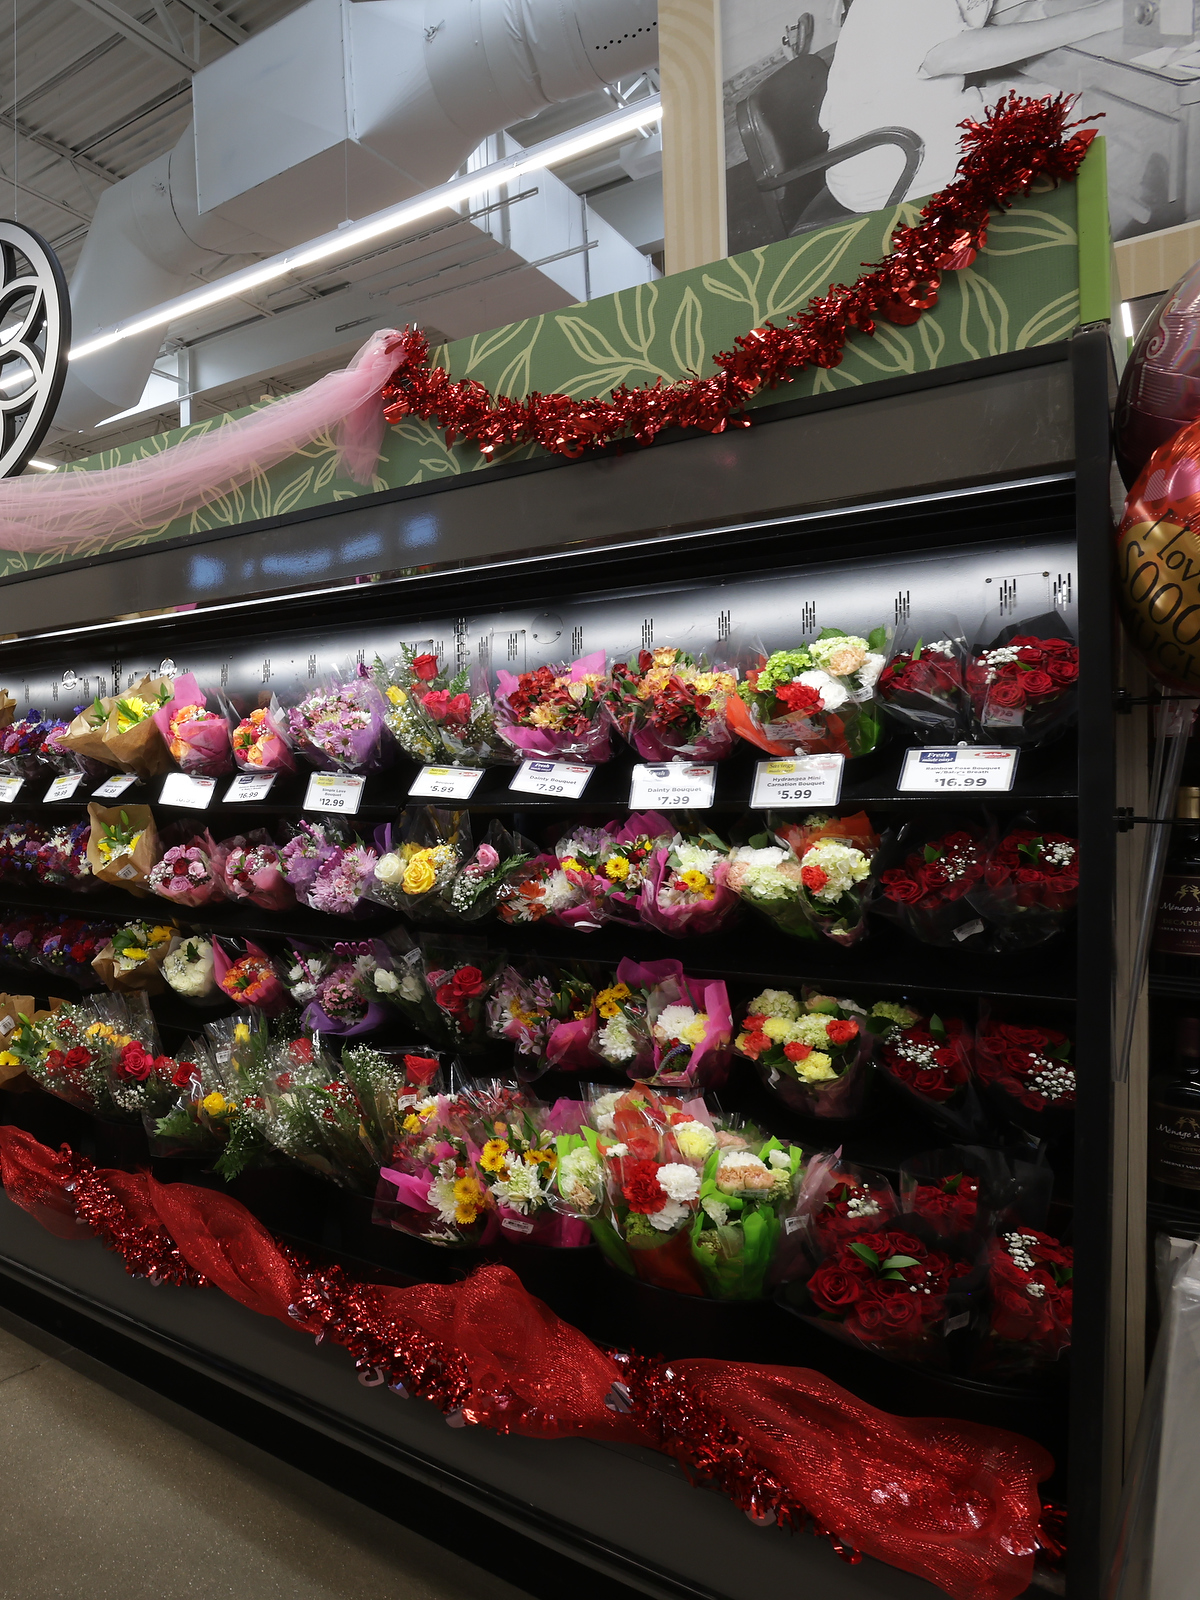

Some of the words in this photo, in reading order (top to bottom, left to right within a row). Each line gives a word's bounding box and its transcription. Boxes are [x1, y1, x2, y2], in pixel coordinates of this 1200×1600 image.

[1142, 507, 1174, 542] I
[1156, 525, 1200, 592] lov
[550, 777, 577, 785] Bouquet
[934, 778, 987, 787] $16.99
[430, 785, 454, 793] $5.99
[536, 783, 564, 793] $7.99
[778, 789, 812, 799] $5.99
[319, 798, 345, 807] $12.99
[658, 796, 690, 805] $7.99
